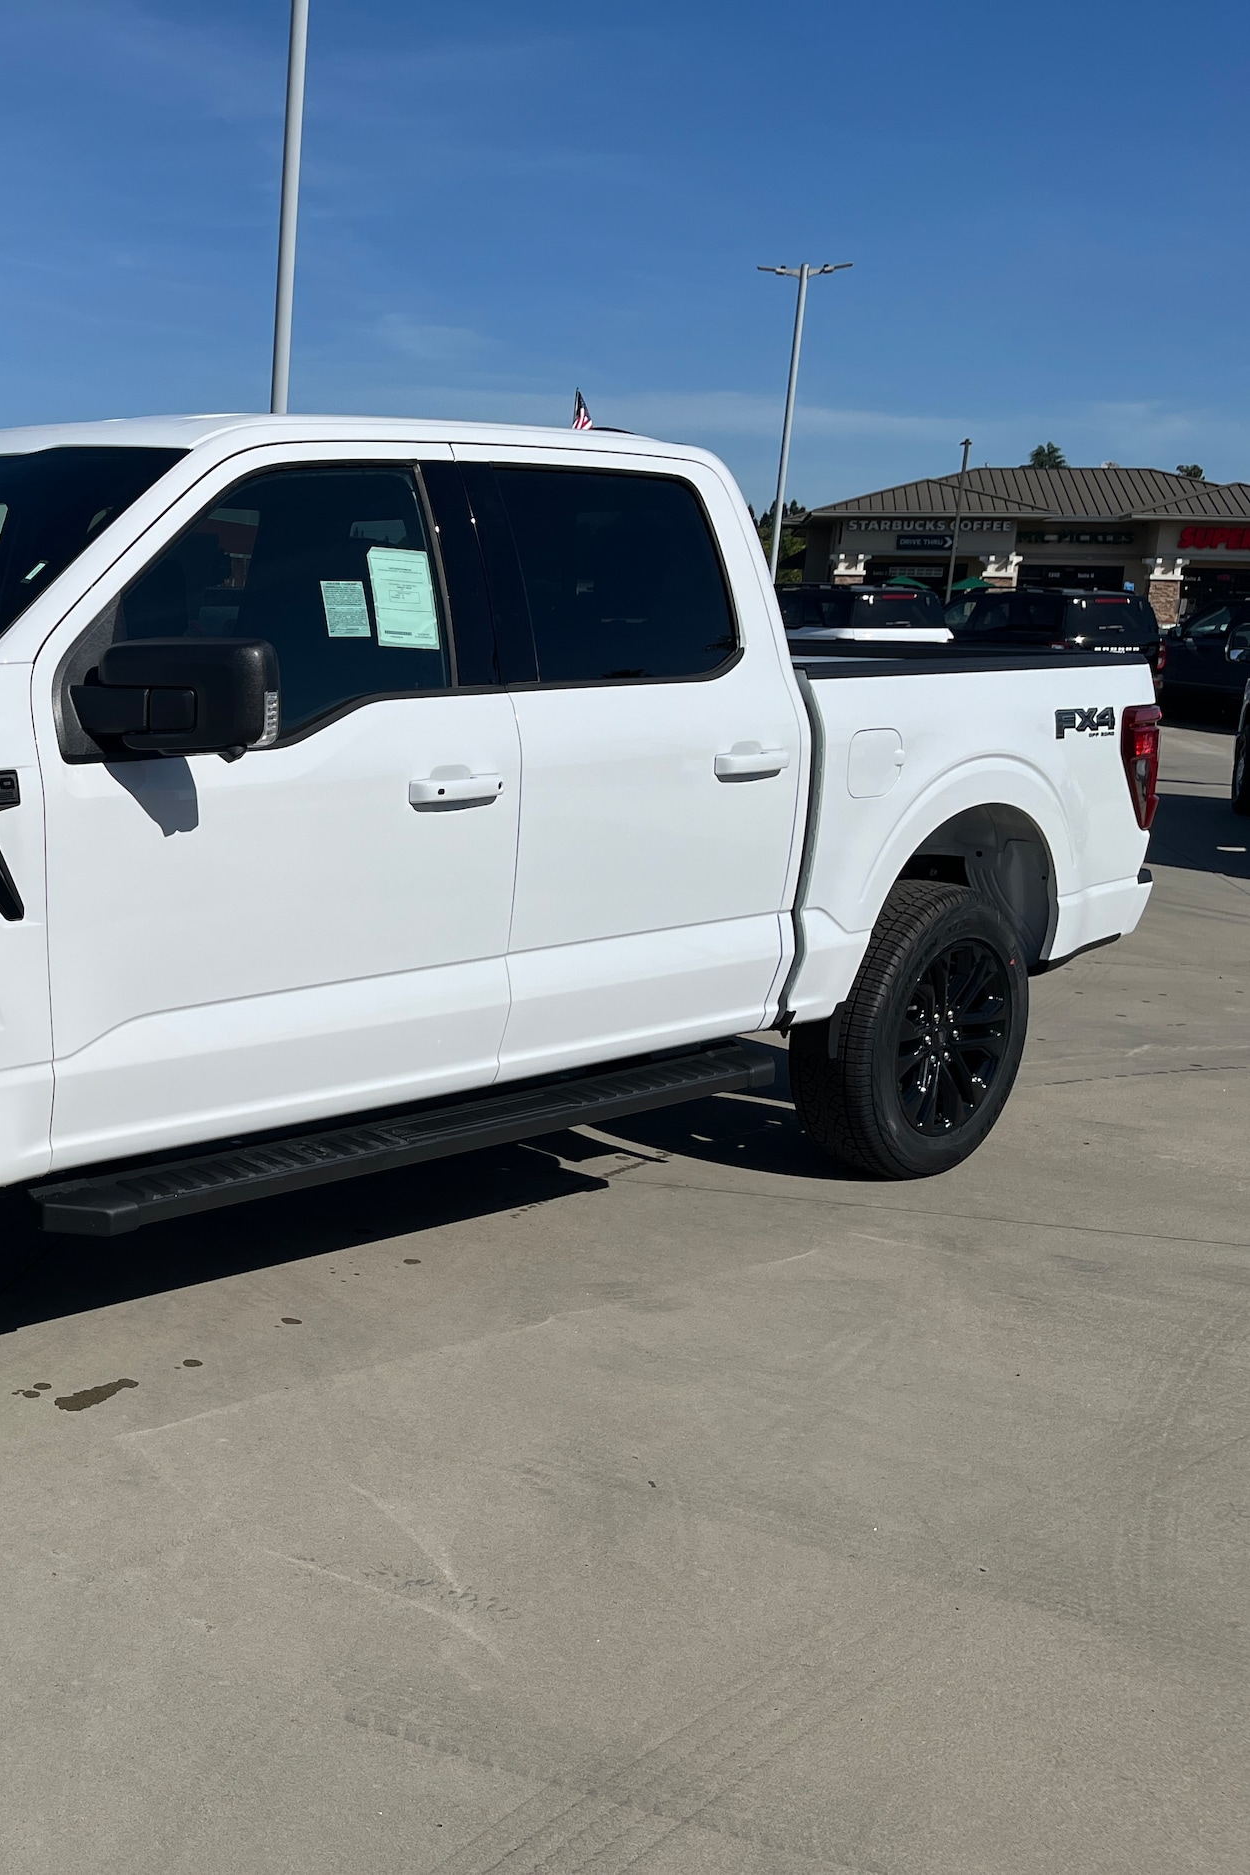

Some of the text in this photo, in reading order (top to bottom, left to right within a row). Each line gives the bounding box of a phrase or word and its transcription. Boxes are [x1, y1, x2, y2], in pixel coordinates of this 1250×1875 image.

[848, 519, 1012, 532] STARBUCKS COFFEE
[899, 538, 922, 546] DRIVE
[1054, 706, 1116, 740] FX4
